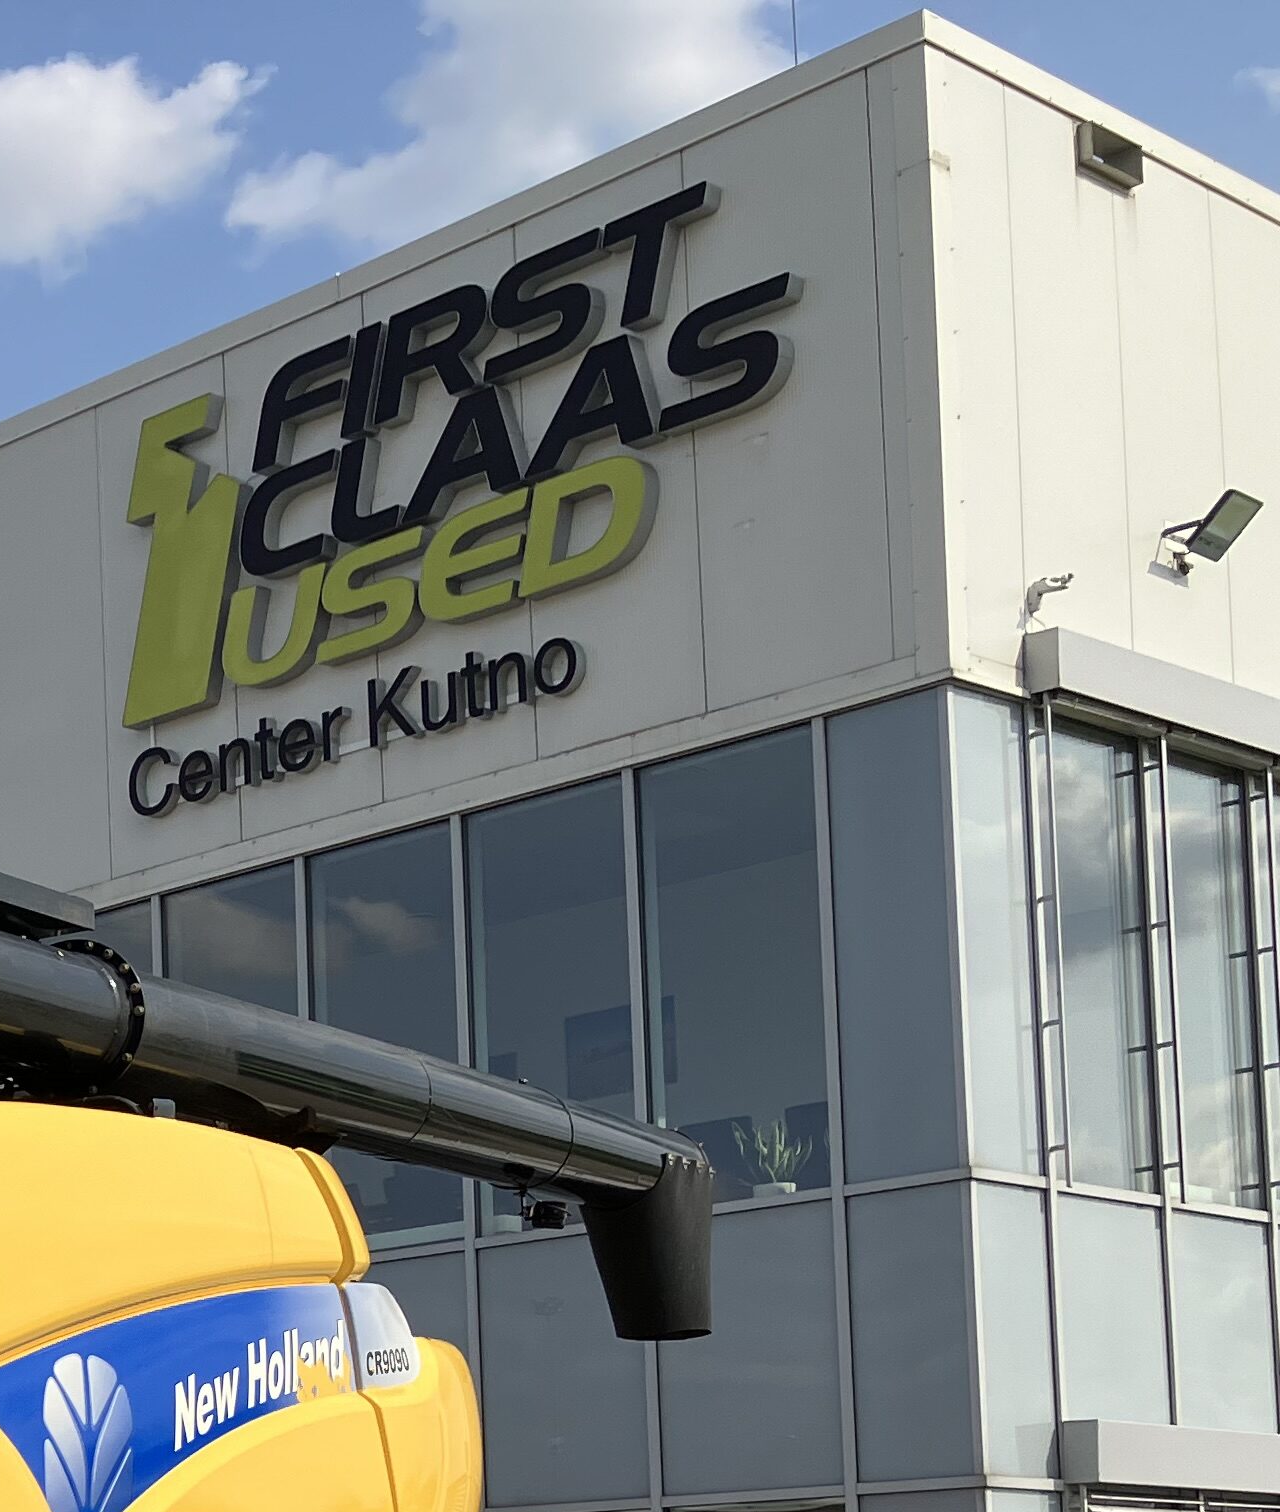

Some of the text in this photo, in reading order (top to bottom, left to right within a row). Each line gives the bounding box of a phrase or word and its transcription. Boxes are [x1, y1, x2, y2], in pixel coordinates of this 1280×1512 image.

[240, 271, 796, 577] CLAAS
[251, 180, 713, 475] FIRST
[222, 455, 652, 688] USED
[128, 636, 581, 818] Center Kutno
[174, 1366, 240, 1452] New
[366, 1347, 410, 1377] CR9090
